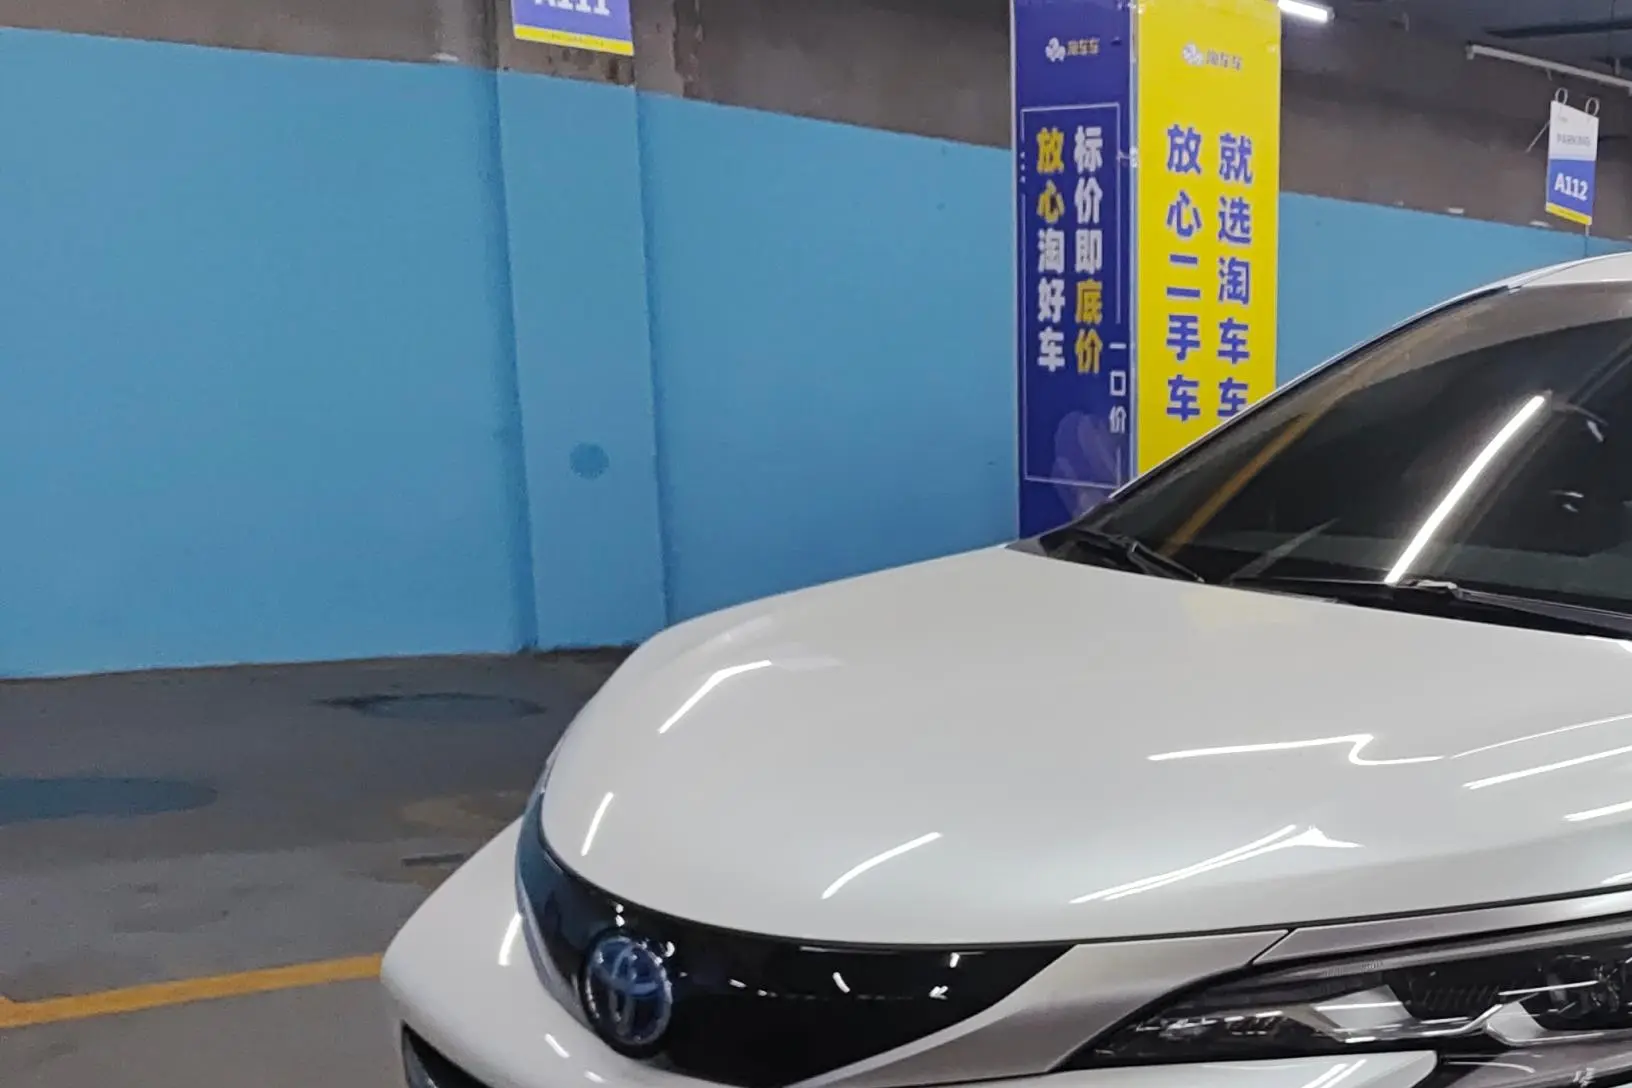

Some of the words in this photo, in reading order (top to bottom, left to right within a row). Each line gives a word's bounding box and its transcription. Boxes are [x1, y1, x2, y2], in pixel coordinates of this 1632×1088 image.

[1036, 127, 1066, 374] 放心淘好车
[1074, 125, 1103, 375] 标价即底价
[1166, 124, 1202, 422] 放心二手车
[1216, 132, 1254, 418] 就选淘车车
[1554, 172, 1588, 201] A112
[1108, 342, 1127, 436] 一口价
